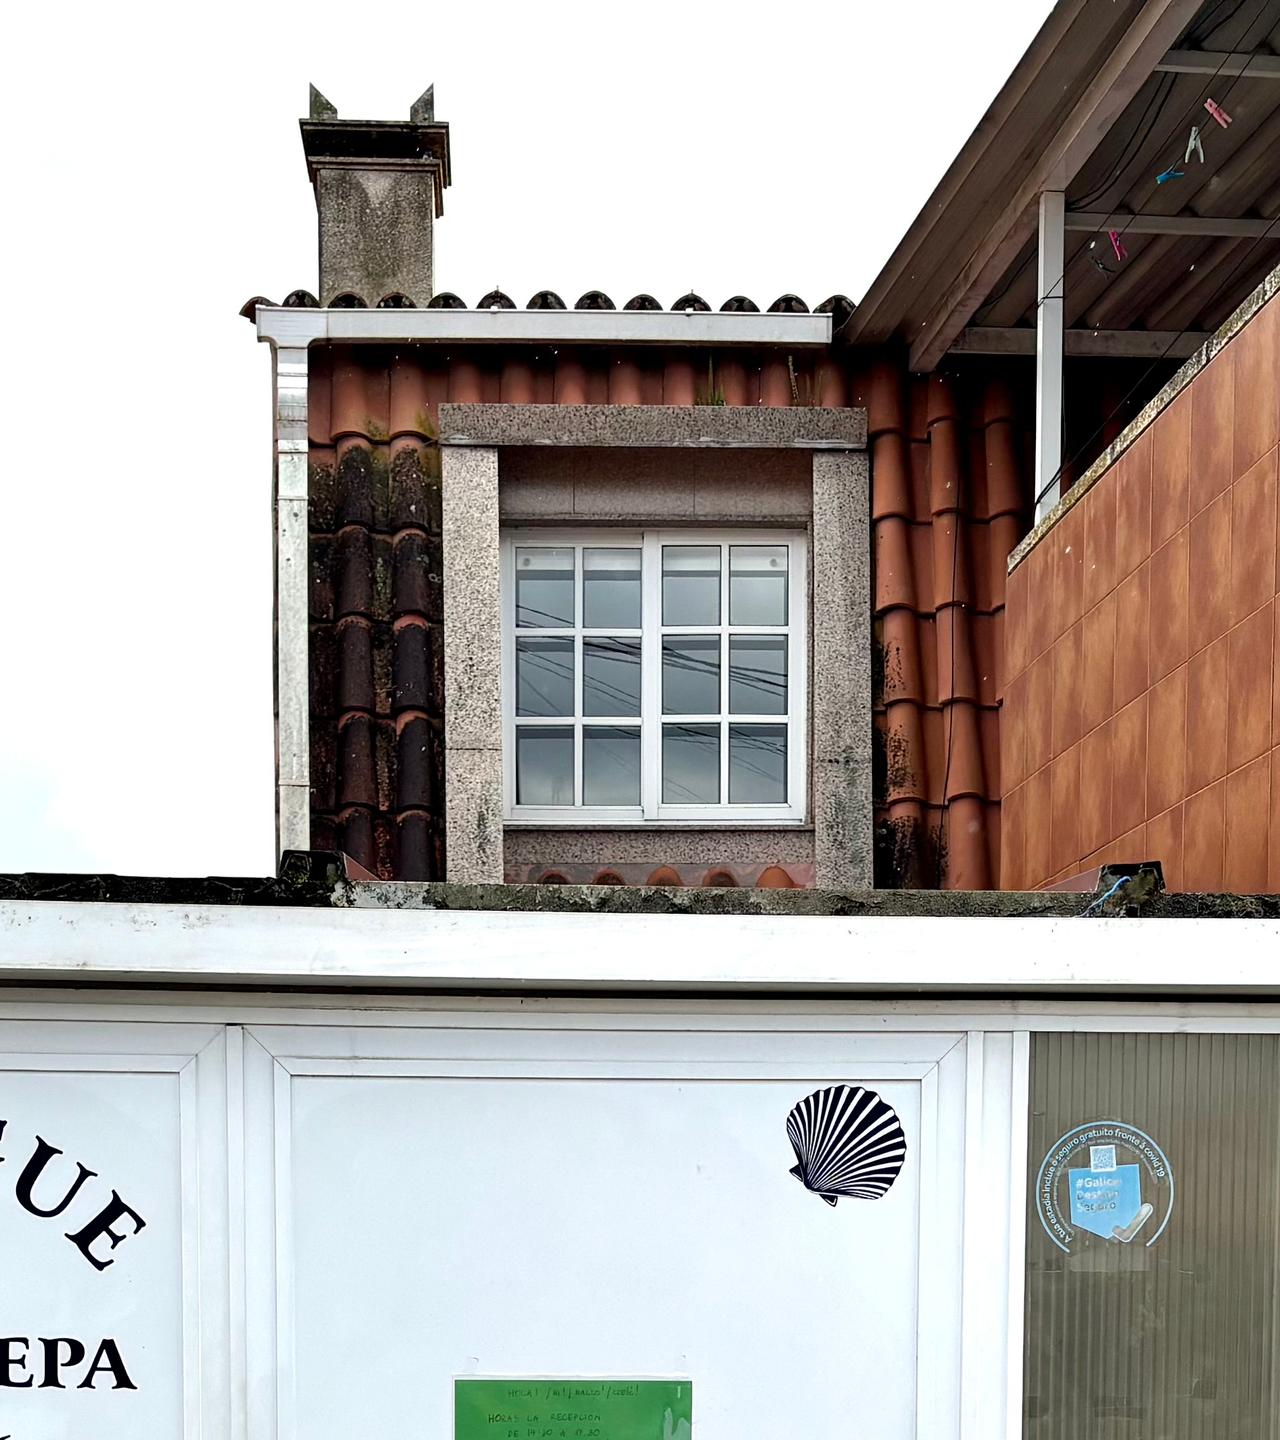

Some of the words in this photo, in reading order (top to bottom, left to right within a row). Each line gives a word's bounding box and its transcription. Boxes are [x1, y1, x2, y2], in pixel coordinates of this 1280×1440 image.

[1115, 1129, 1140, 1145] fronte
[1056, 1138, 1079, 1161] seguro
[1065, 1235, 1072, 1243] A
